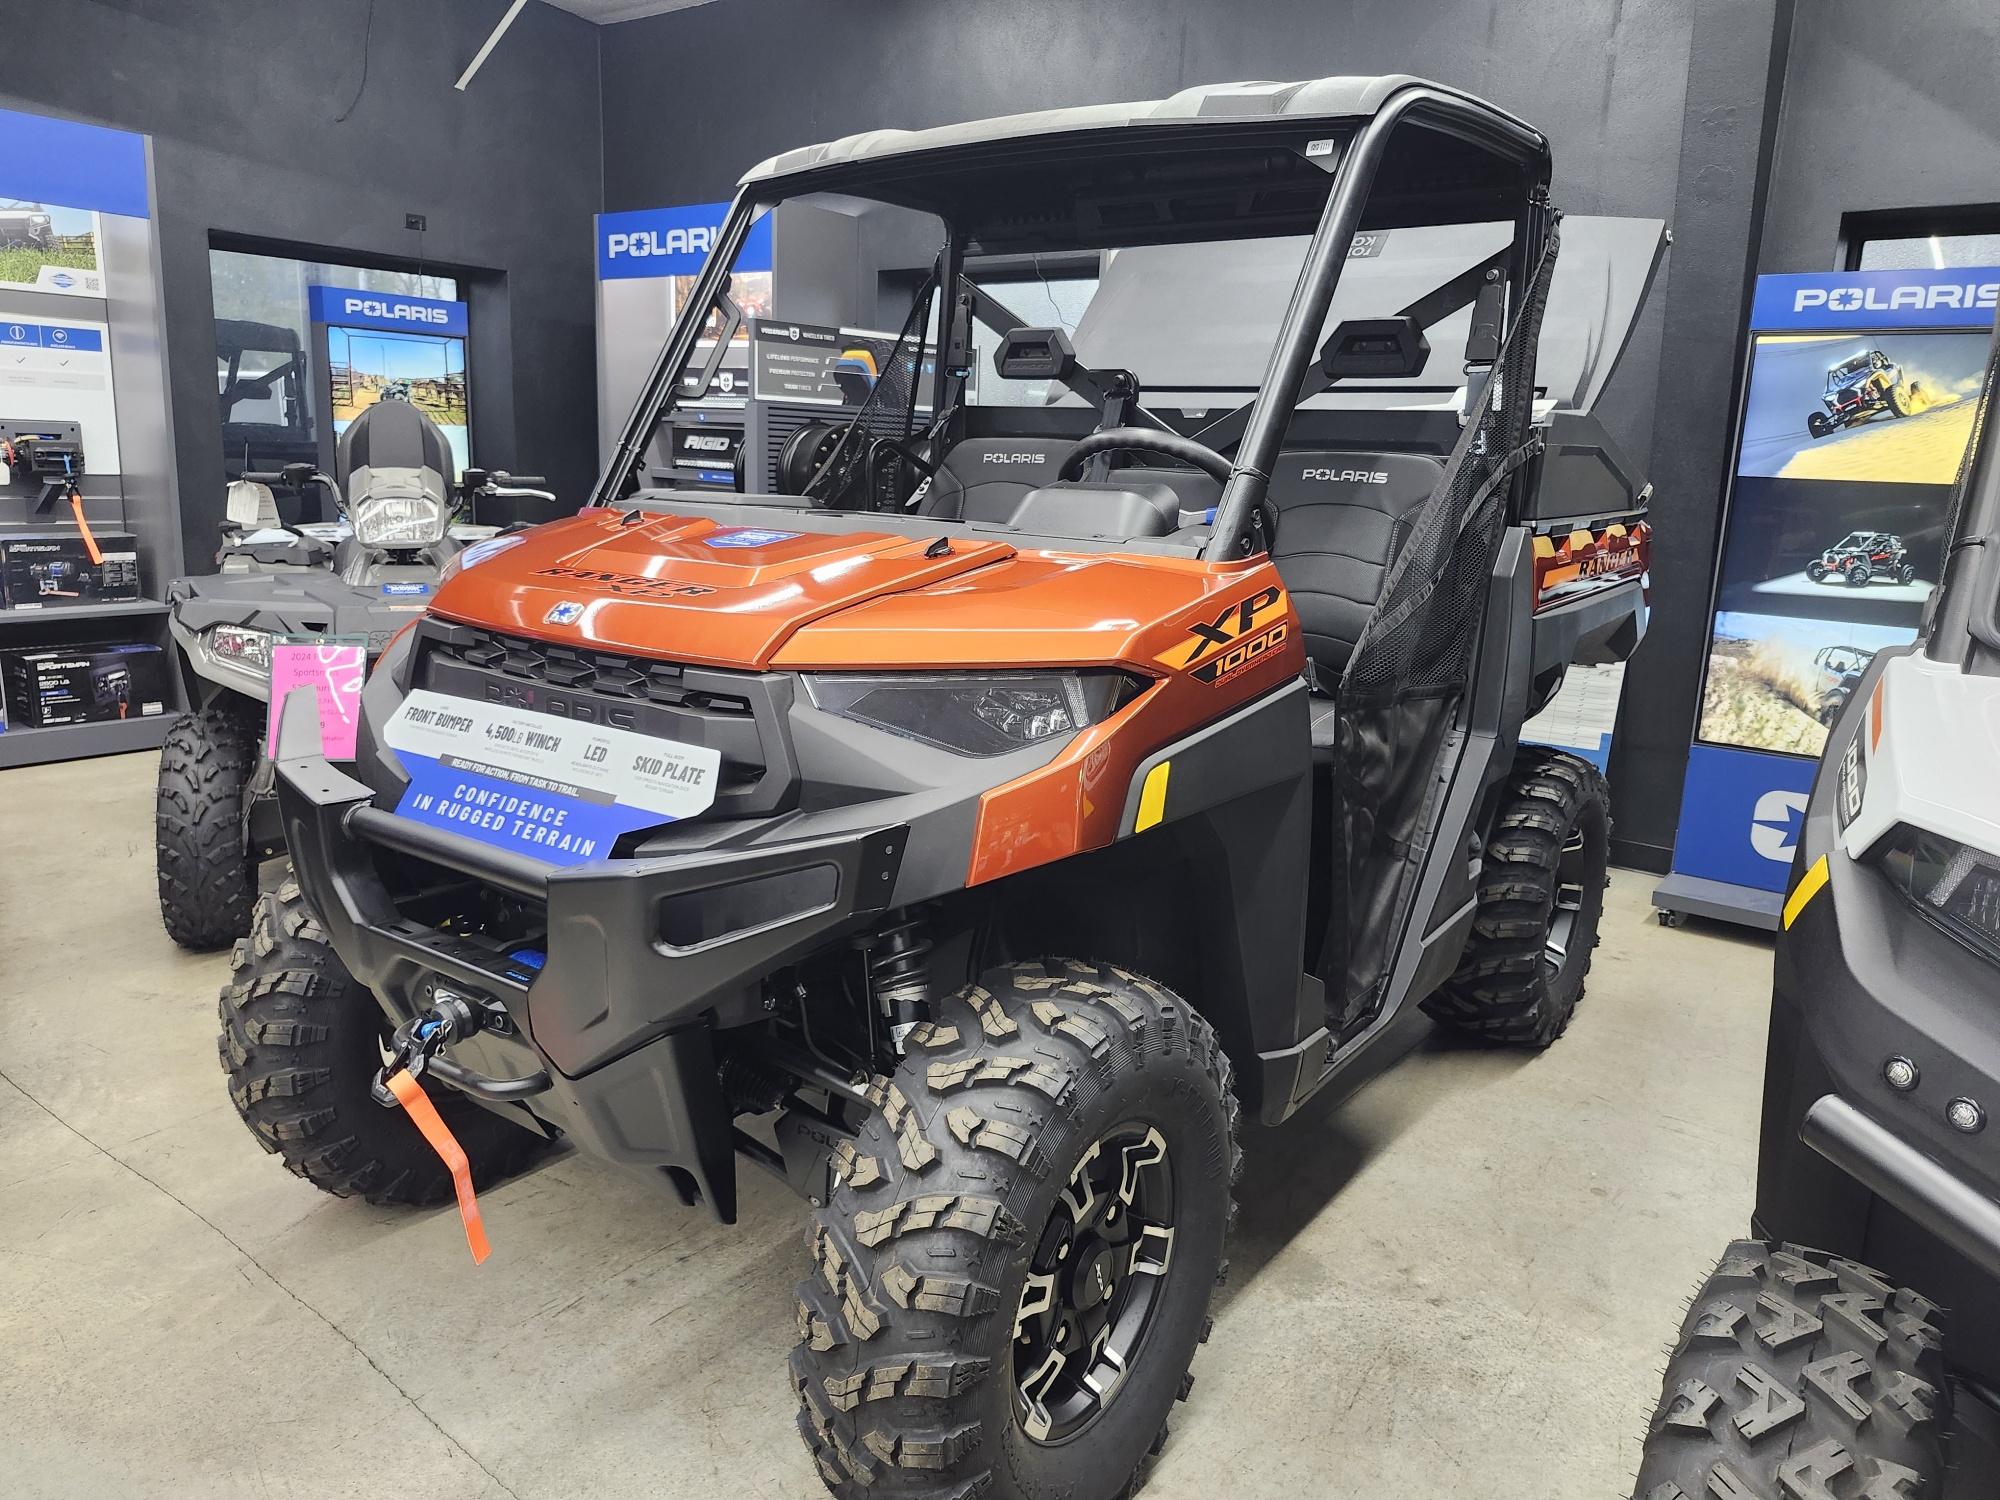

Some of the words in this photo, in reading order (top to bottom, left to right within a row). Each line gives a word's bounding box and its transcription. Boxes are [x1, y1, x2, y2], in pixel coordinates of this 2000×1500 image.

[608, 226, 721, 259] POLARI
[345, 298, 449, 324] POLARIS
[684, 435, 730, 451] RIGID
[983, 453, 1046, 465] POLARIS
[1302, 469, 1388, 484] POLARIS
[1577, 548, 1635, 579] RANGER
[1182, 585, 1281, 667] XP
[1215, 623, 1288, 677] 1000
[405, 706, 437, 725] FRONT
[435, 712, 474, 733] BUMPER
[524, 731, 562, 752] WINCH
[584, 744, 609, 763] LED
[451, 758, 474, 770] READY
[472, 763, 487, 774] FOR
[485, 766, 511, 780] ACTION,
[510, 772, 530, 784] FROM
[529, 777, 548, 789] TASK
[548, 782, 558, 792] TO
[558, 784, 581, 797] TRAIL.
[632, 755, 664, 776] SKID
[662, 762, 705, 785] PLATE
[454, 784, 569, 828] CONFIDENCE
[412, 793, 433, 811] IN
[436, 799, 506, 832] RUGGED
[511, 820, 596, 857] TERRAIN
